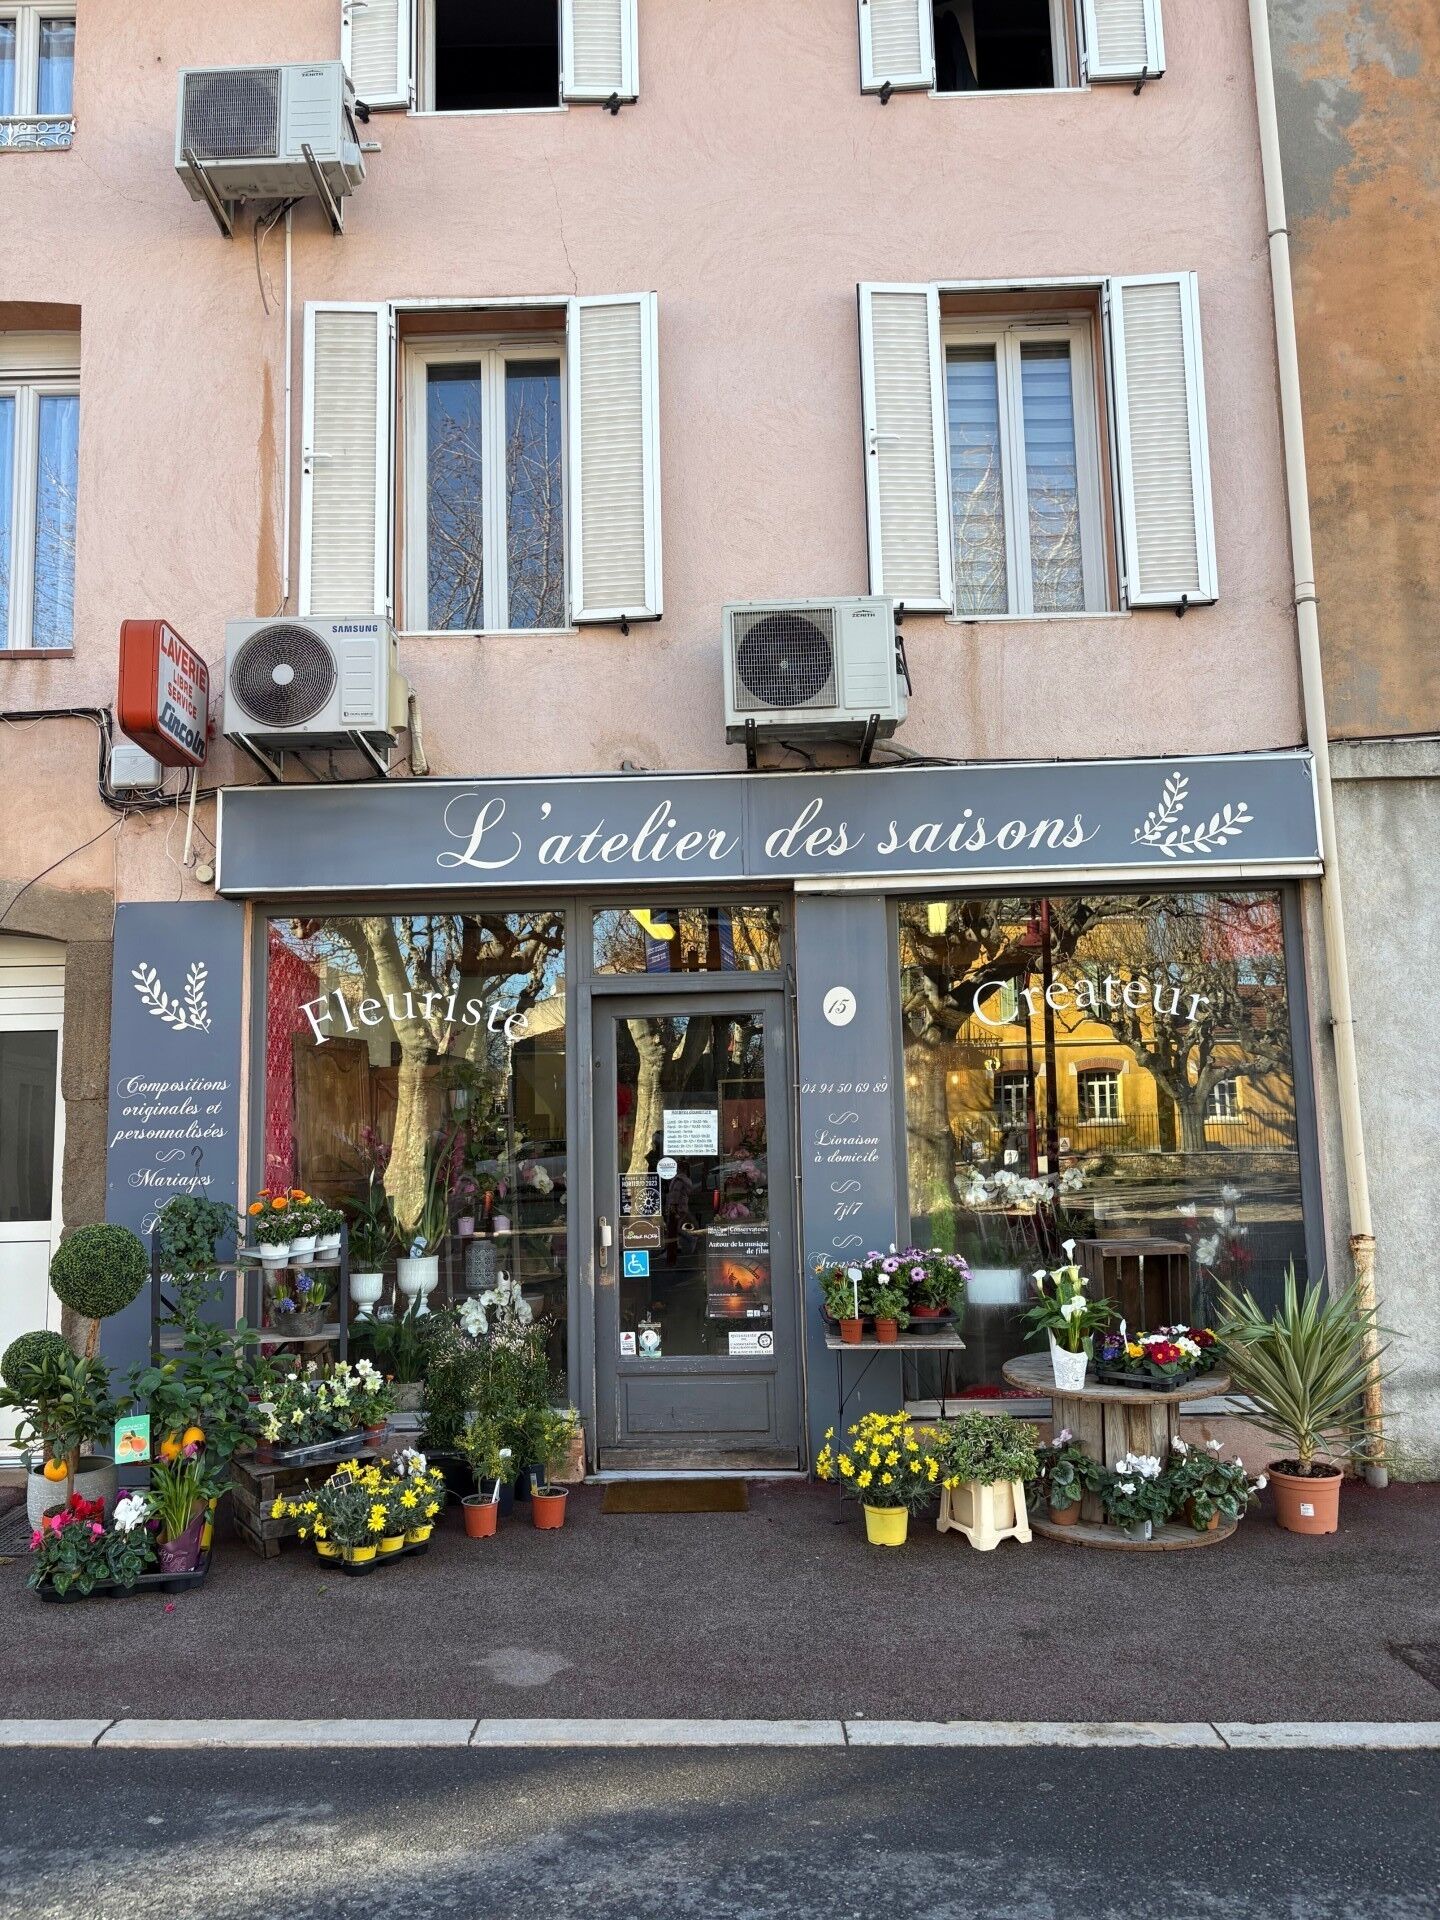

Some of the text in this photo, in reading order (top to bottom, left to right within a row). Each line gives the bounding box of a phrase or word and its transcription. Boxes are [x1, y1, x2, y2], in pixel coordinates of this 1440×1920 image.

[332, 624, 378, 633] SAMSUNG
[161, 627, 206, 694] LAVERIE
[173, 669, 193, 700] LIBRE
[167, 682, 198, 721] SERVICE
[159, 701, 206, 760] Lincoln
[437, 793, 1101, 869] L'atelier des saisons
[299, 982, 529, 1046] Fleuriste
[828, 999, 850, 1014] 15
[117, 1075, 231, 1100] Compositions
[802, 1083, 888, 1093] 04 94 50 69 89
[122, 1096, 222, 1123] originales et
[110, 1120, 229, 1148] personnalisées
[814, 1129, 880, 1146] Livraison
[815, 1149, 880, 1163] à domicile
[128, 1168, 214, 1193] Mariages
[834, 1202, 863, 1221] 7j/7
[745, 1241, 769, 1249] musique
[756, 1246, 769, 1255] film
